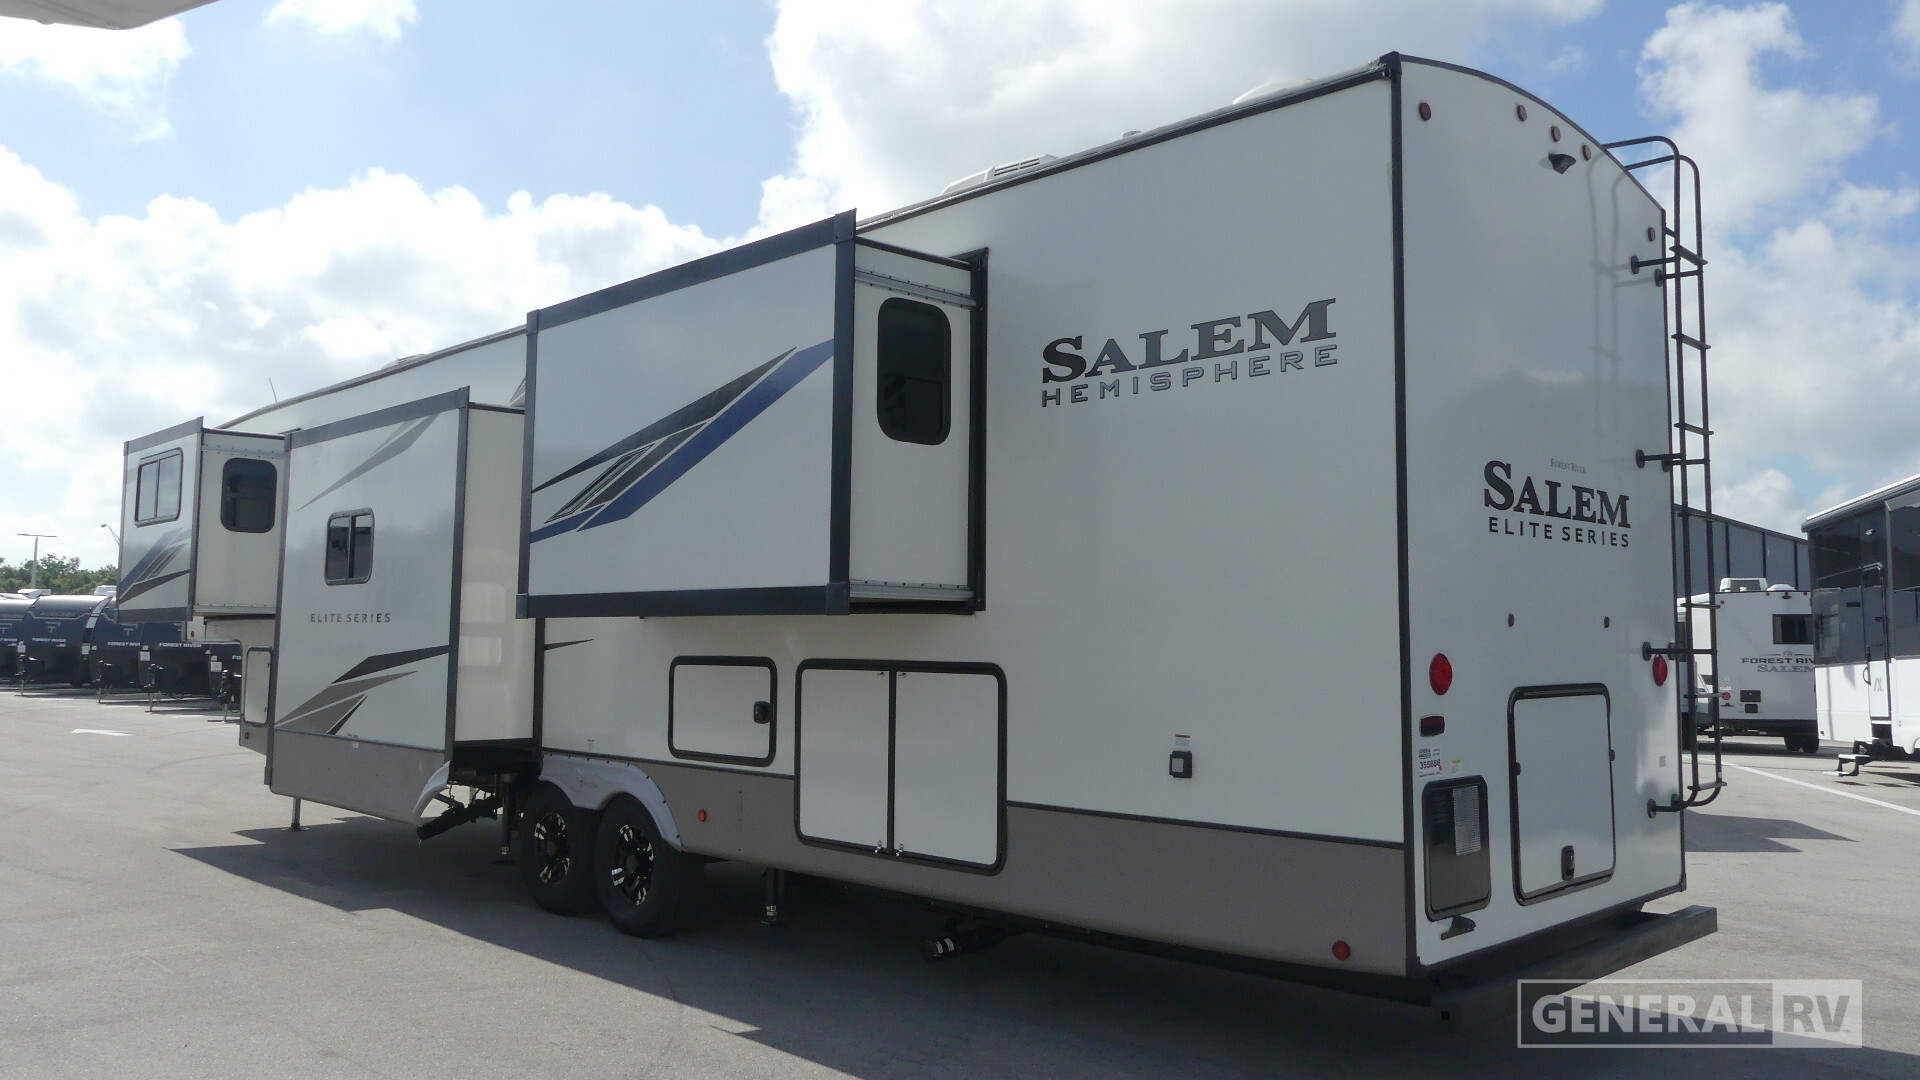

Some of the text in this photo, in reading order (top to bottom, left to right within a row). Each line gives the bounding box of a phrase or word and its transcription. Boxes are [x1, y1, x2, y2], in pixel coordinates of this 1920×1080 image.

[1043, 298, 1337, 383] SALEM
[1041, 344, 1338, 407] HEMISPHERE
[1484, 460, 1631, 529] SALEM
[1489, 516, 1629, 548] ELITE SERIES
[311, 613, 391, 623] ELITE SERIES
